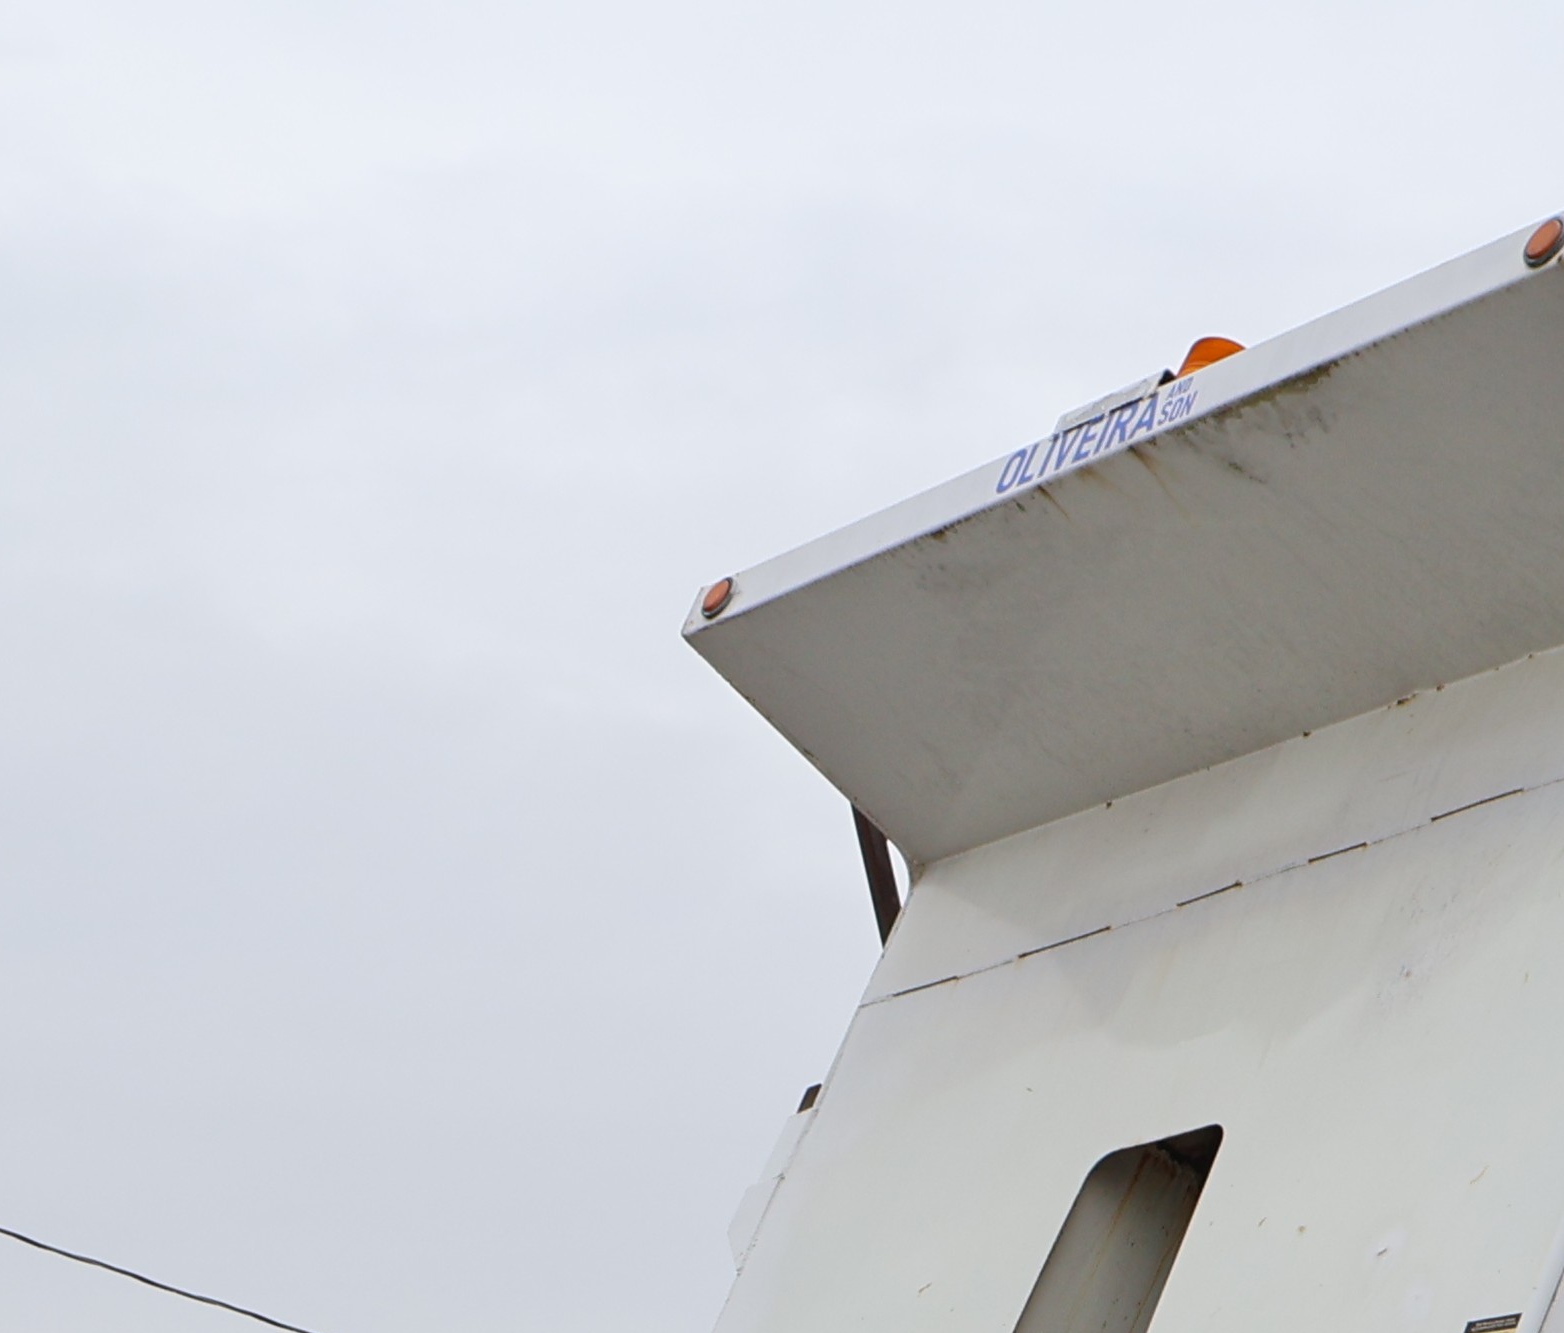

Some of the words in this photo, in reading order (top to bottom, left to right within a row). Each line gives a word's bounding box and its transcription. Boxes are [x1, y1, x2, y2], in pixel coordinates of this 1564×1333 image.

[1167, 376, 1194, 399] AND
[1157, 391, 1198, 426] SON
[995, 391, 1160, 495] OLIVEIRA
